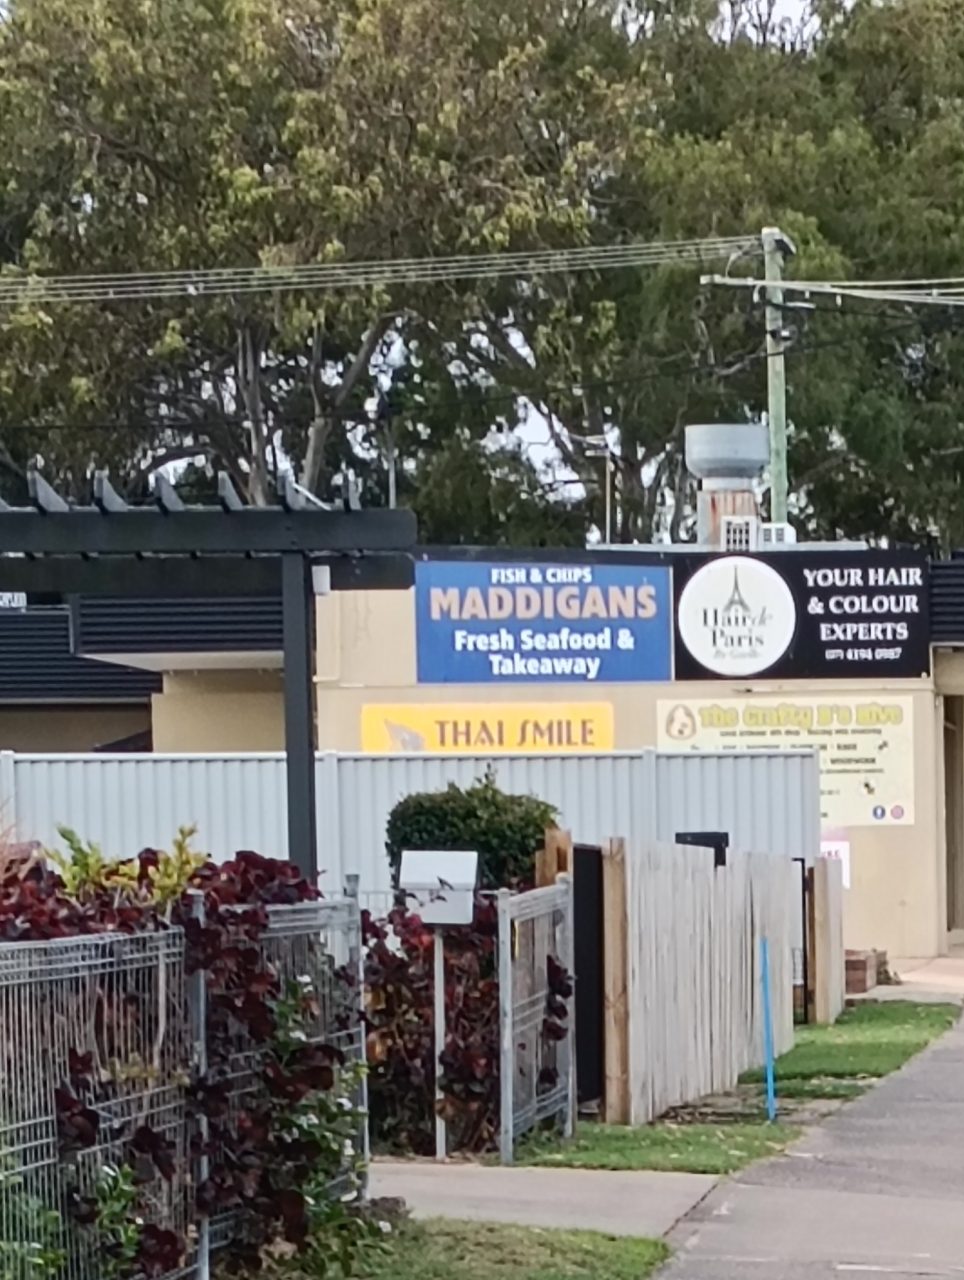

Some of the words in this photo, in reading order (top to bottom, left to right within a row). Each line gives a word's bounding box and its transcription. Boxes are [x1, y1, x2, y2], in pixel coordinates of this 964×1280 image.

[491, 568, 526, 583] FISH
[530, 568, 541, 583] &
[546, 567, 592, 583] CHIPS
[803, 568, 864, 587] YOUR
[868, 567, 923, 586] HAIR
[430, 586, 657, 620] MADDIGANS
[807, 596, 824, 614] &
[829, 594, 919, 614] COLOUR
[455, 628, 514, 650] Fresh
[520, 627, 611, 650] Seafood
[617, 628, 634, 649] &
[712, 629, 765, 647] Paris
[820, 622, 909, 641] EXPERTS
[489, 653, 600, 679] Takeaway
[435, 719, 504, 746] THAI
[517, 718, 595, 746] SMILE
